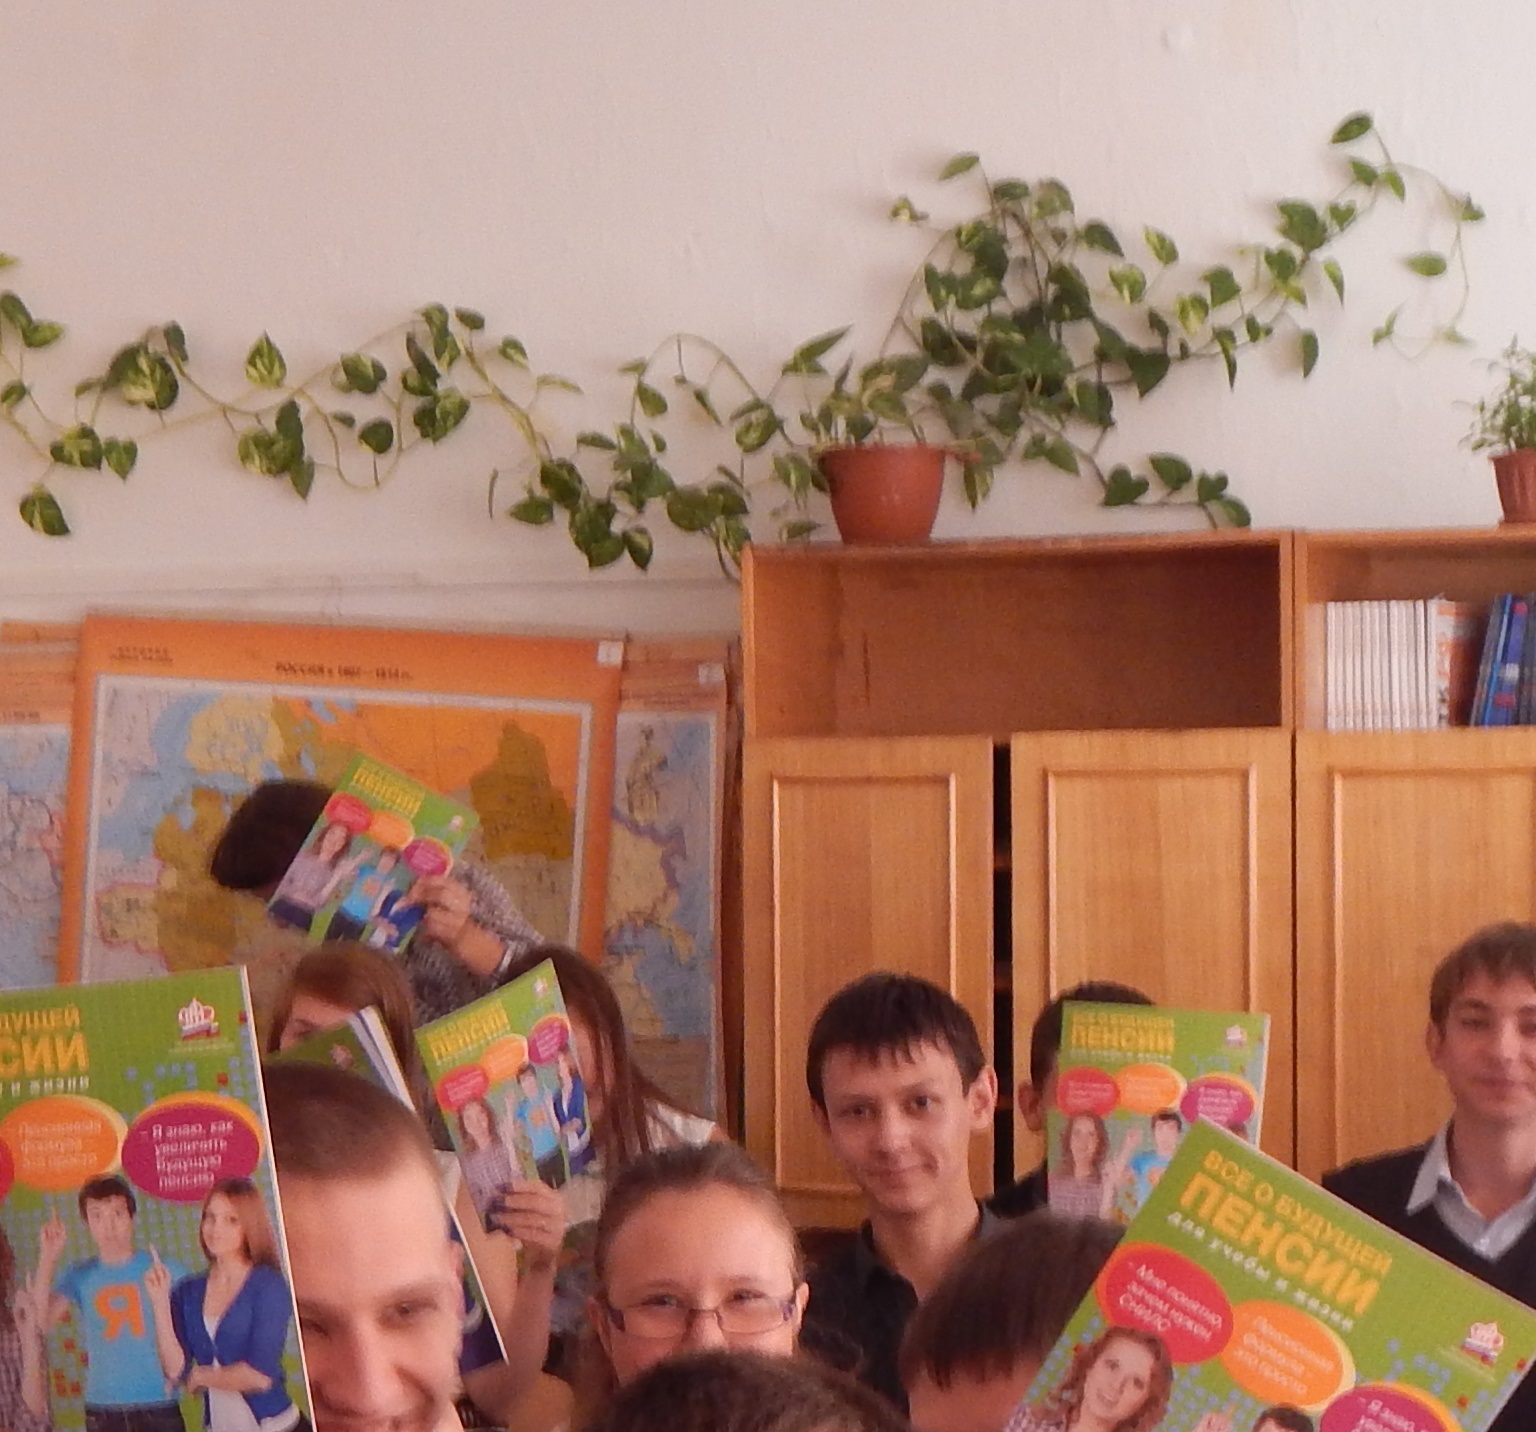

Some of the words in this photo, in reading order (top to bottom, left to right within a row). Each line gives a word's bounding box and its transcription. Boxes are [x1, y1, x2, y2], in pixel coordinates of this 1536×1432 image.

[1204, 1150, 1254, 1192] ВСЕ
[1255, 1182, 1274, 1203] О
[1180, 1171, 1380, 1315] ПЕНСИИ
[94, 1282, 146, 1341] Я
